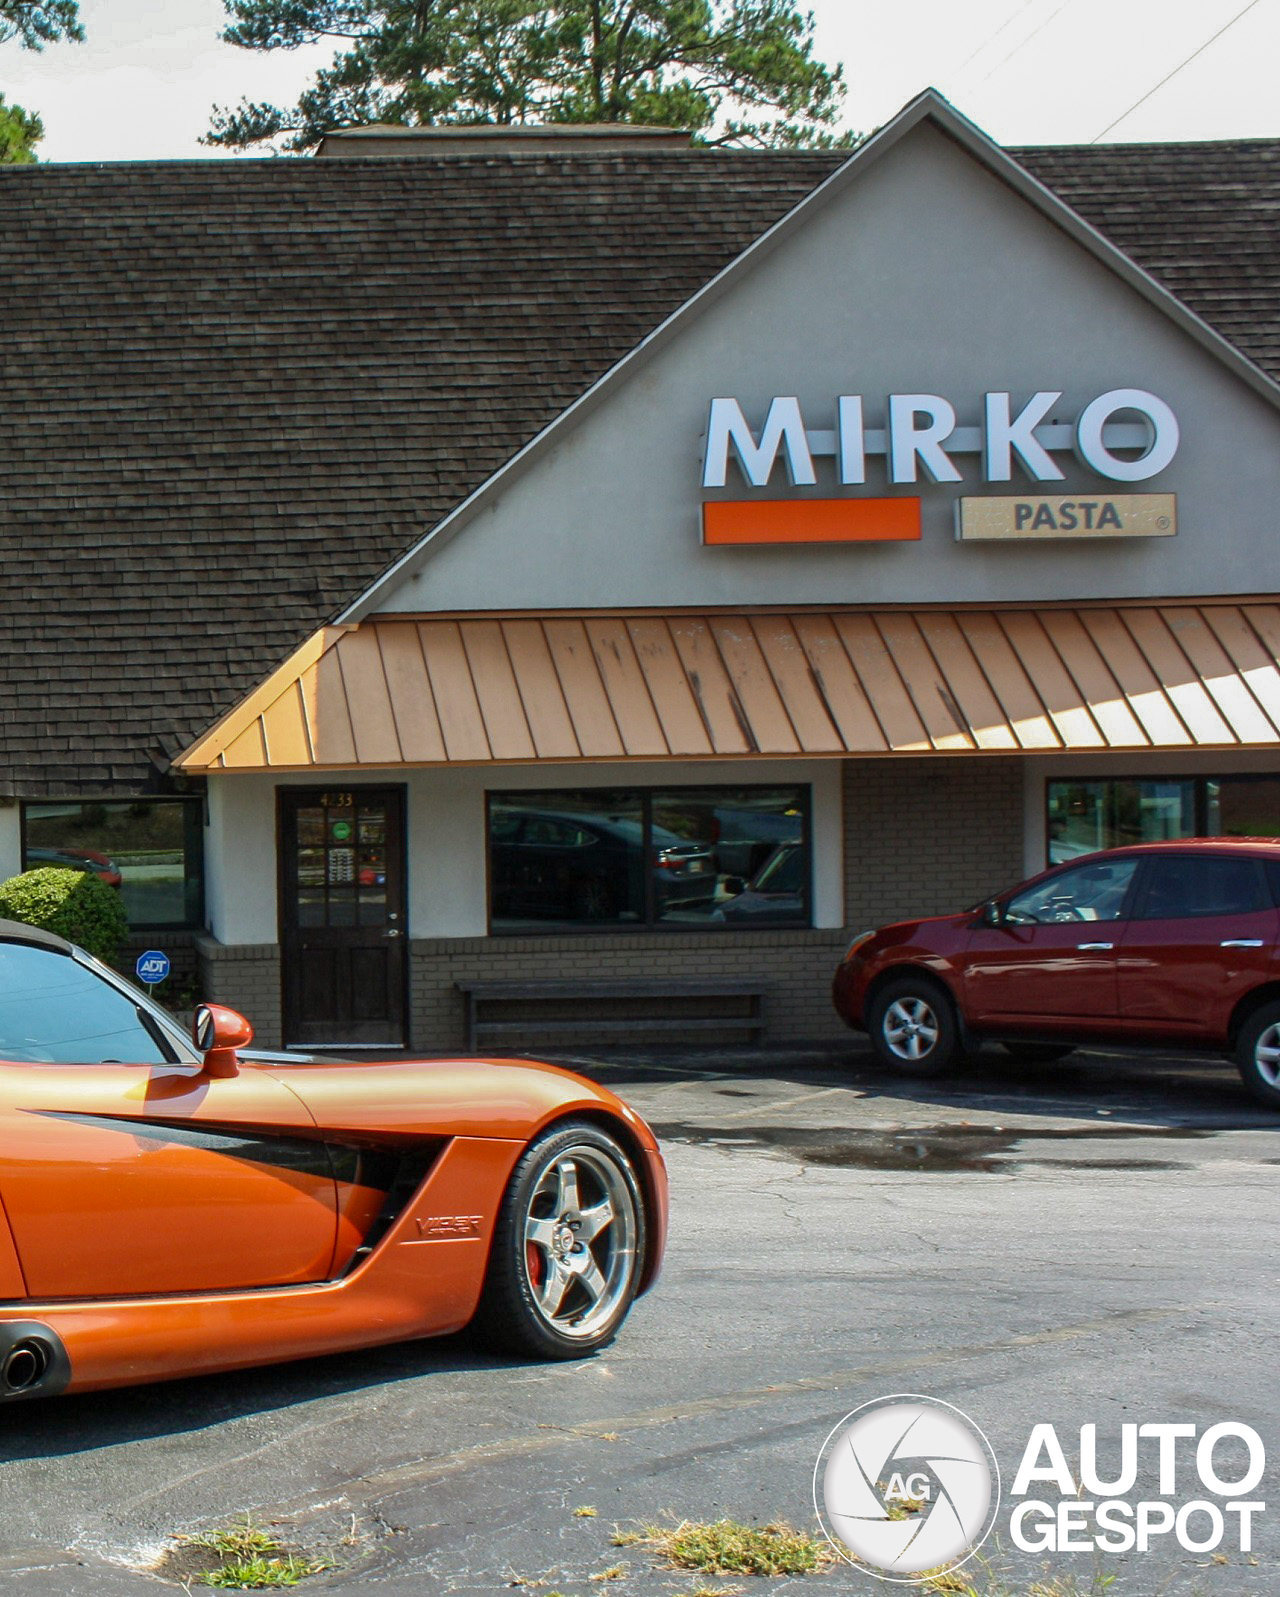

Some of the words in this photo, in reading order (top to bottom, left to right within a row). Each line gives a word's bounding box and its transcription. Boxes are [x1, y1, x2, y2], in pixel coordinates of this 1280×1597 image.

[702, 388, 1180, 488] MIRKO
[1014, 501, 1123, 531] PASTA
[320, 792, 353, 807] 433
[140, 959, 167, 972] ADT
[416, 1214, 483, 1236] VIPER
